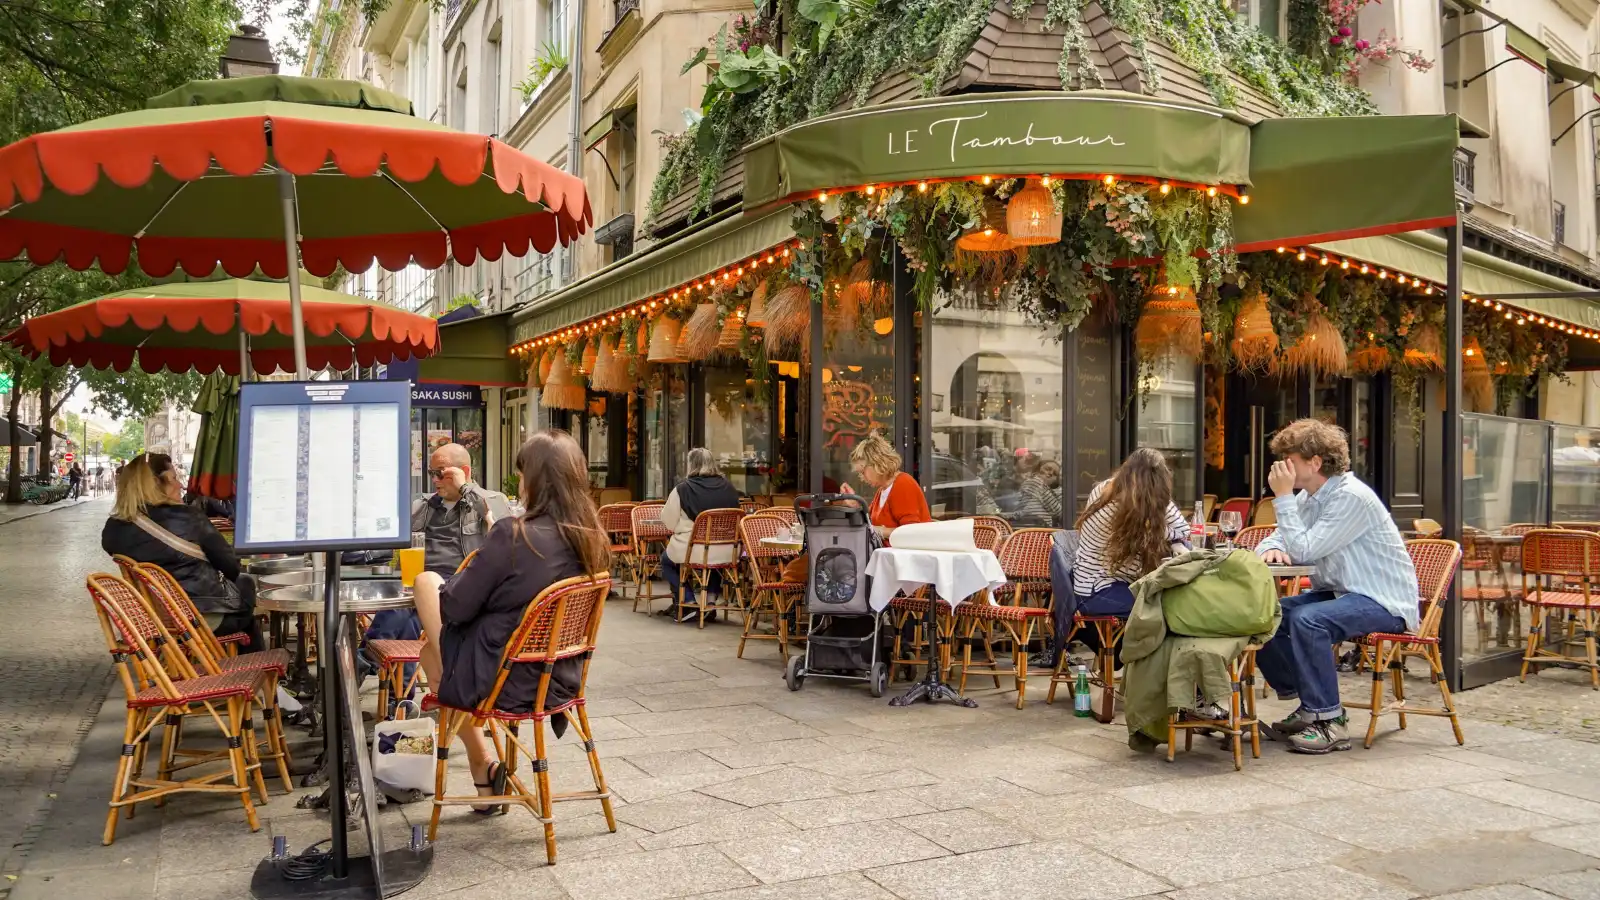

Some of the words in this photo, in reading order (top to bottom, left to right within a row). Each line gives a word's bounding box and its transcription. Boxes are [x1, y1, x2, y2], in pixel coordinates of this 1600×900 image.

[888, 129, 918, 154] LE
[929, 110, 1126, 162] Tambour
[411, 390, 441, 400] SAKA
[442, 391, 472, 400] SUSHI
